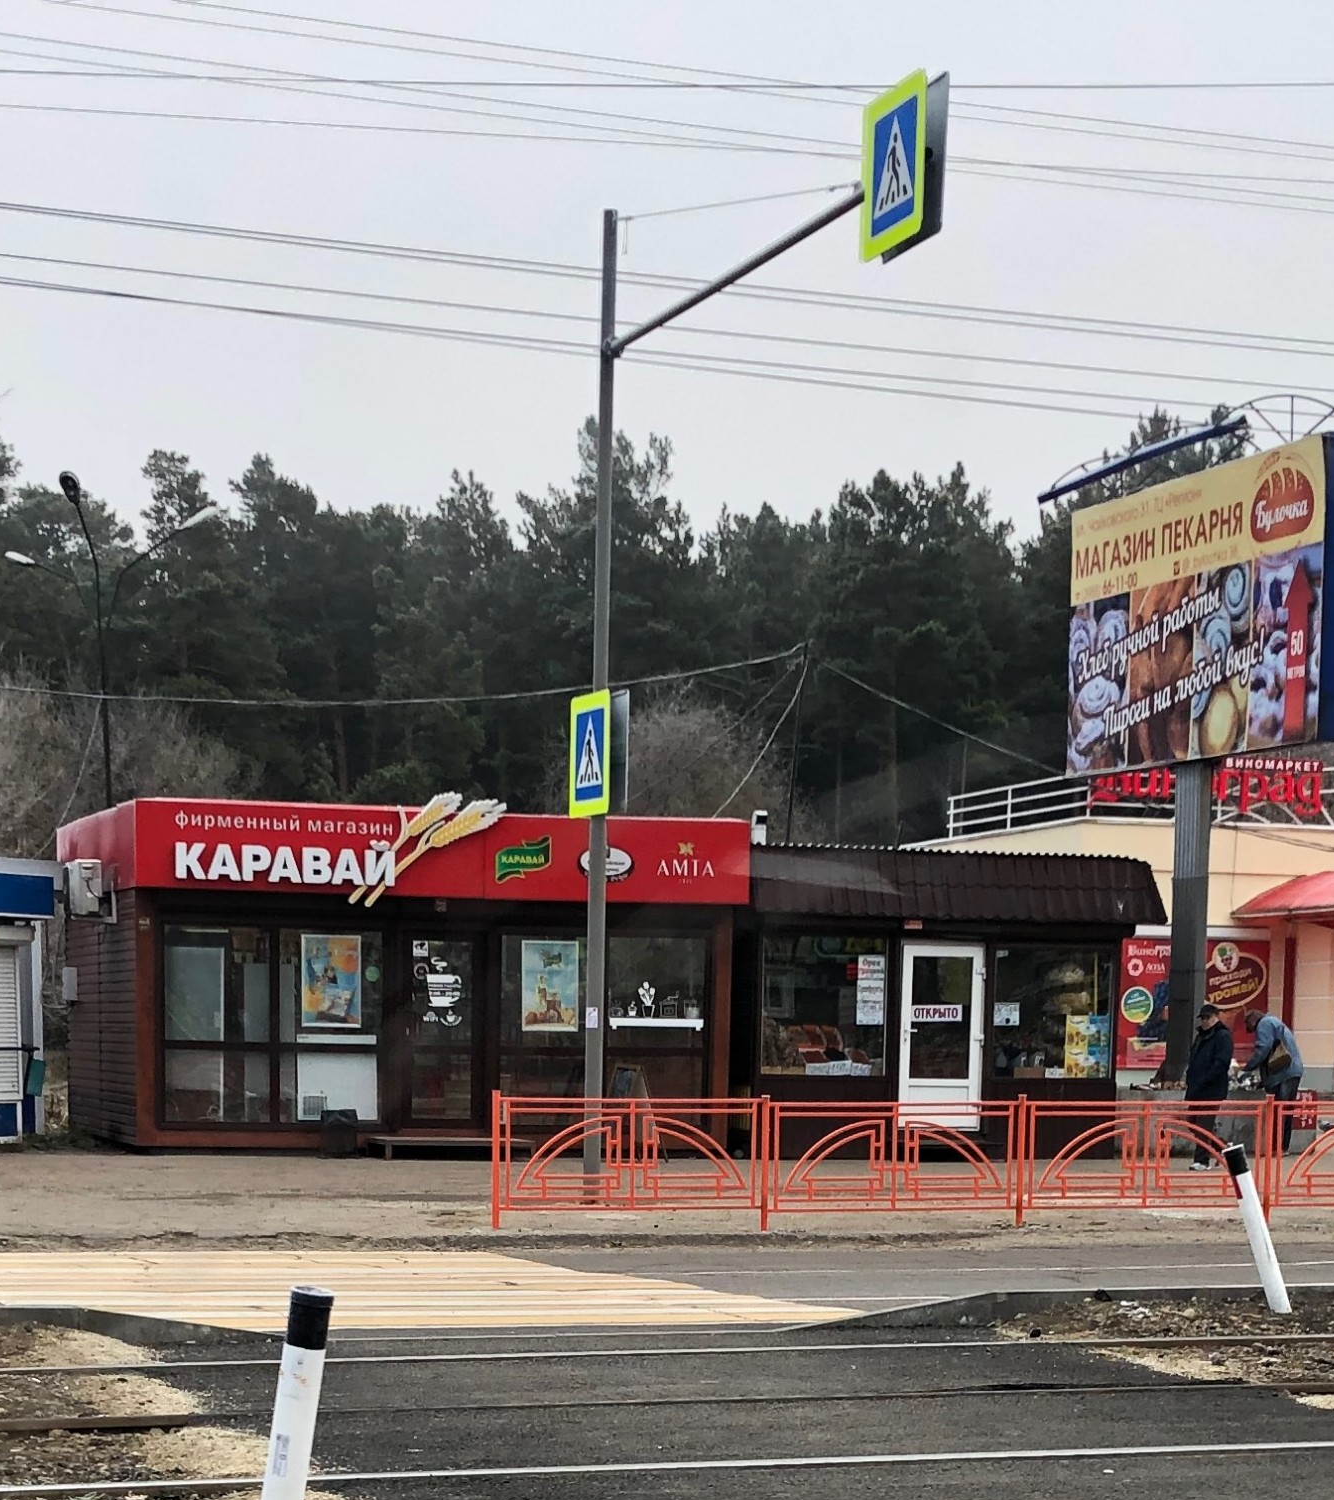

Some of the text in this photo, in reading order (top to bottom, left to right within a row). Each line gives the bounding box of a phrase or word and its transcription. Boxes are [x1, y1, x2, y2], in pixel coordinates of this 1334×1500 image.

[1255, 498, 1309, 533] Булочка
[1076, 527, 1156, 580] МАГАЗИН
[1161, 501, 1244, 556] ПЕКАРНЯ
[1078, 587, 1222, 683] Хлеб ручной работы
[1290, 629, 1304, 657] 50
[1103, 627, 1266, 746] Пироги на любой вкус!
[1225, 756, 1321, 773] ВИНОМАРКЕТ
[175, 810, 394, 836] фирменный магазин
[174, 839, 397, 888] КАРАВАЙ
[501, 853, 546, 865] КАРАВАЙ
[913, 1006, 959, 1020] ОТКРЫТО
